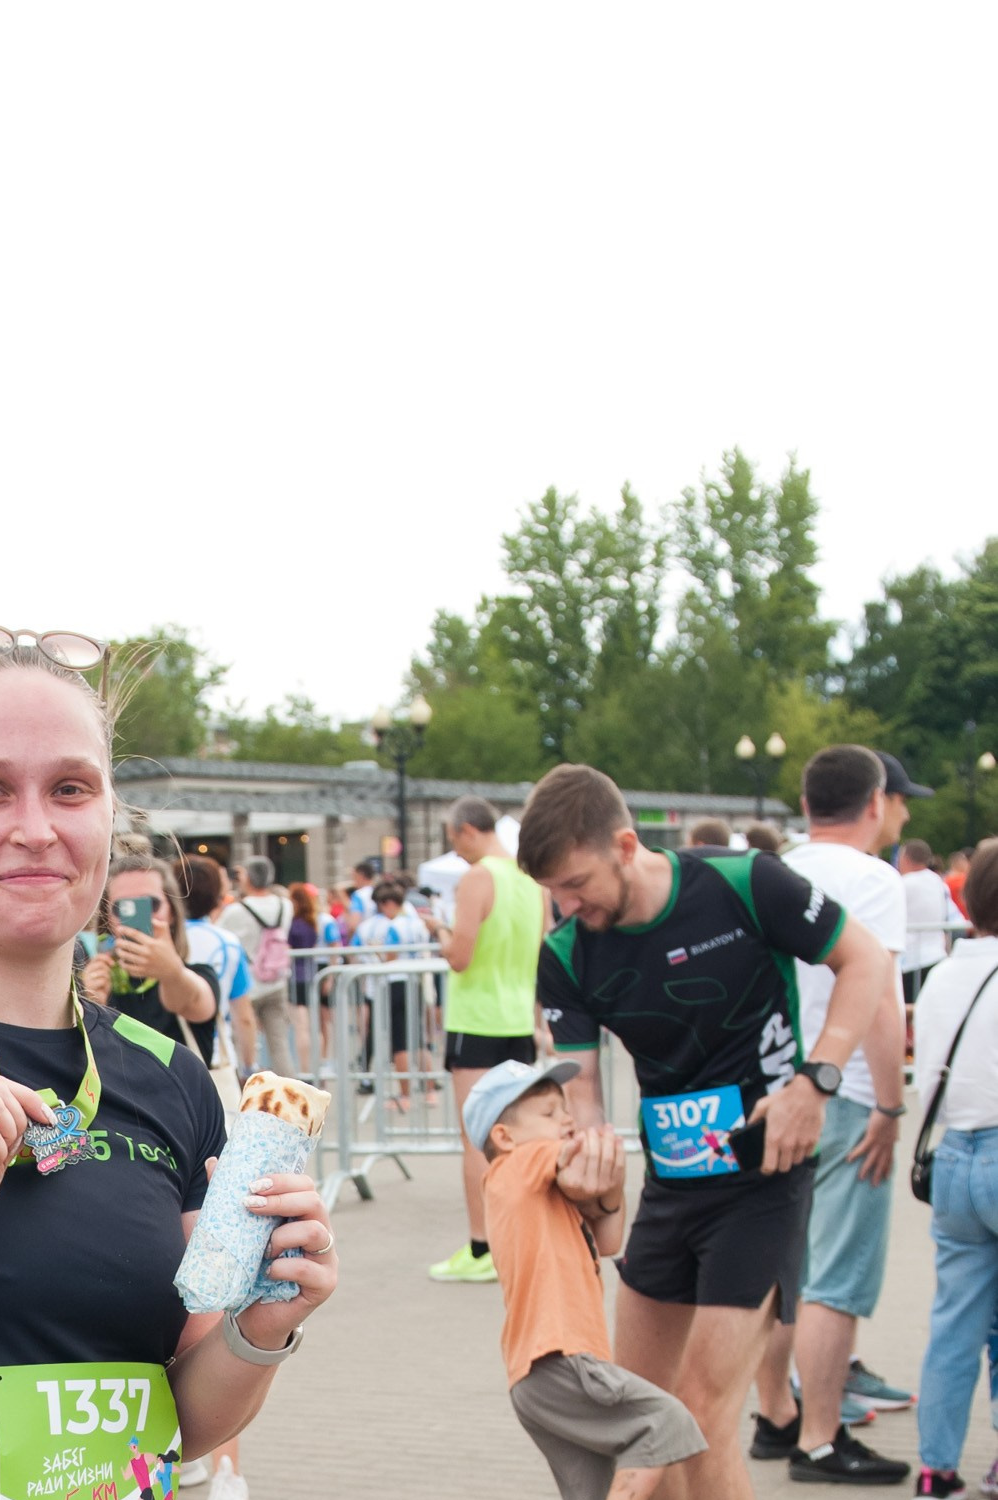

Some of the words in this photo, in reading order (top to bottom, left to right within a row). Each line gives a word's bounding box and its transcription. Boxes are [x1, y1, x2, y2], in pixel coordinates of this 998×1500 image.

[652, 1095, 720, 1130] 3107
[36, 1378, 151, 1435] 1337
[42, 1447, 86, 1475] ЗАБЕГ
[27, 1474, 63, 1498] РАДИ
